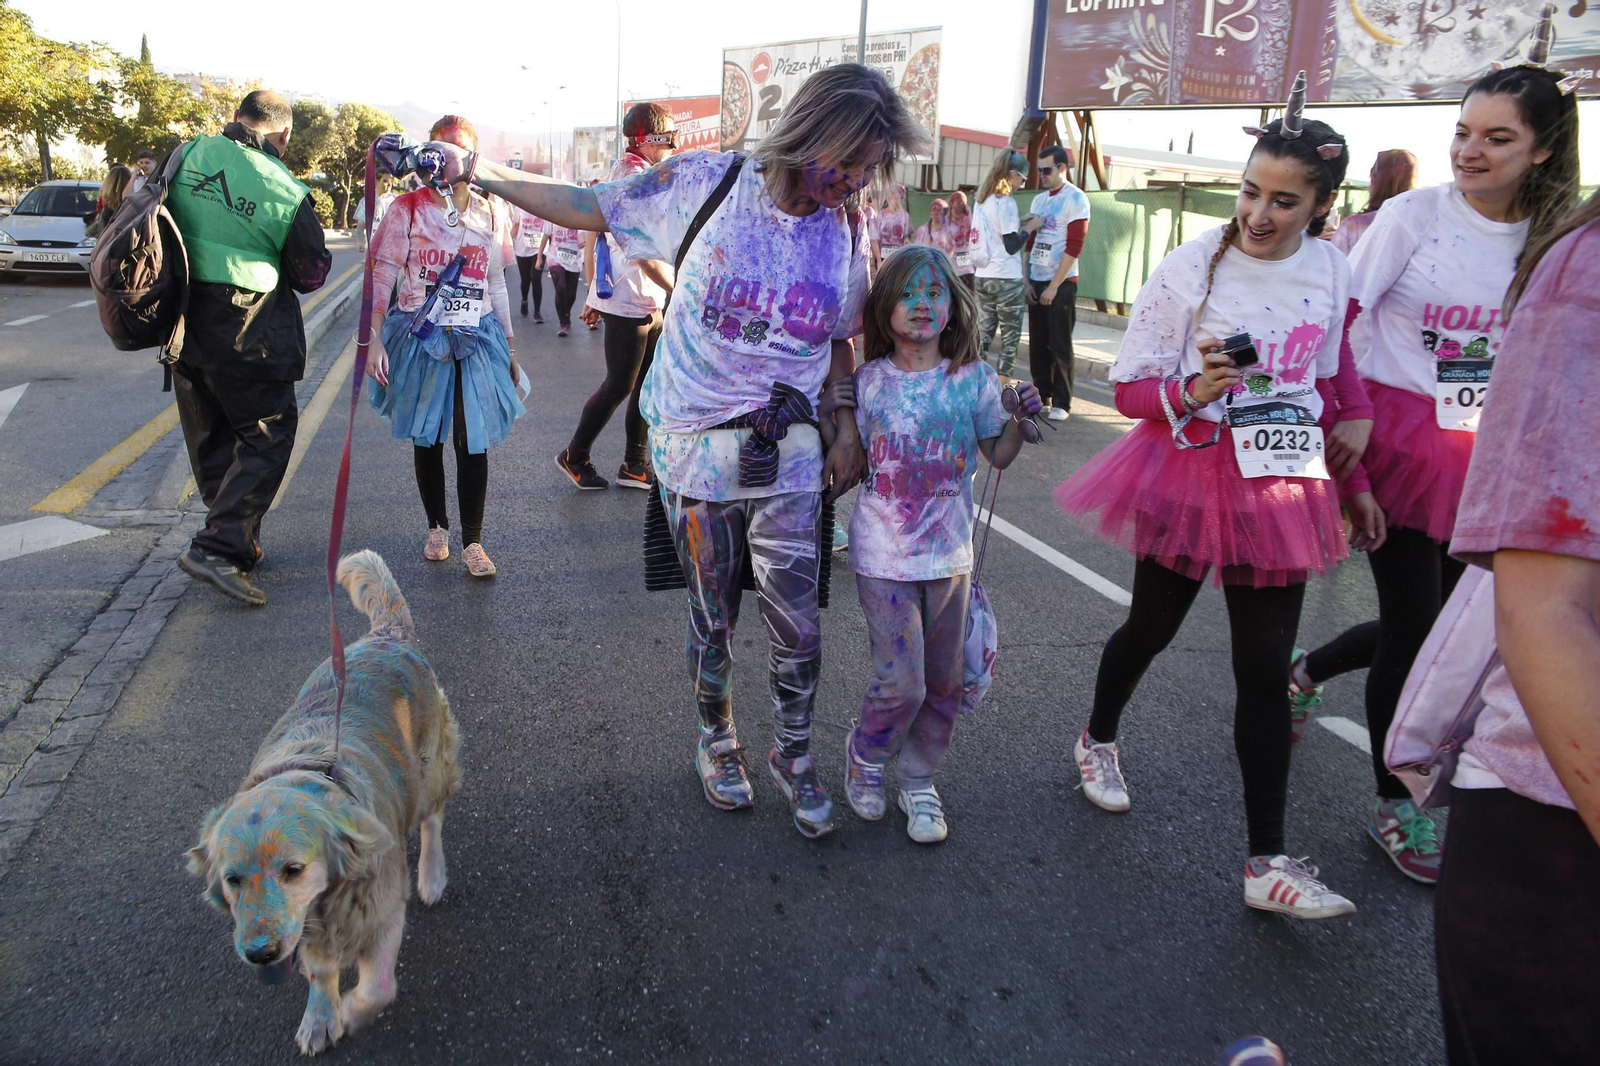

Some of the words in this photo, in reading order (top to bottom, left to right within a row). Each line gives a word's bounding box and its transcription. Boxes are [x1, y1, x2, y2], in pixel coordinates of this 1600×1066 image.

[870, 40, 895, 52] precios
[774, 58, 807, 77] Pizza
[809, 56, 835, 73] Hut
[882, 52, 893, 63] en
[894, 50, 906, 62] PH!
[1186, 67, 1230, 84] PREMIUM
[1236, 75, 1256, 86] GIN
[1182, 80, 1260, 100] MEDITERRÁNEA
[757, 84, 782, 122] 2
[674, 110, 692, 121] NADA!
[675, 120, 701, 134] RTURA
[190, 190, 206, 200] Sports
[234, 196, 256, 217] 38
[418, 249, 454, 266] HOLI
[468, 251, 486, 272] ife
[704, 276, 778, 318] HOLI
[1422, 303, 1500, 333] HOLI
[1234, 414, 1269, 424] GRANADA
[868, 432, 910, 469] HOLI
[1255, 429, 1310, 452] 0232
